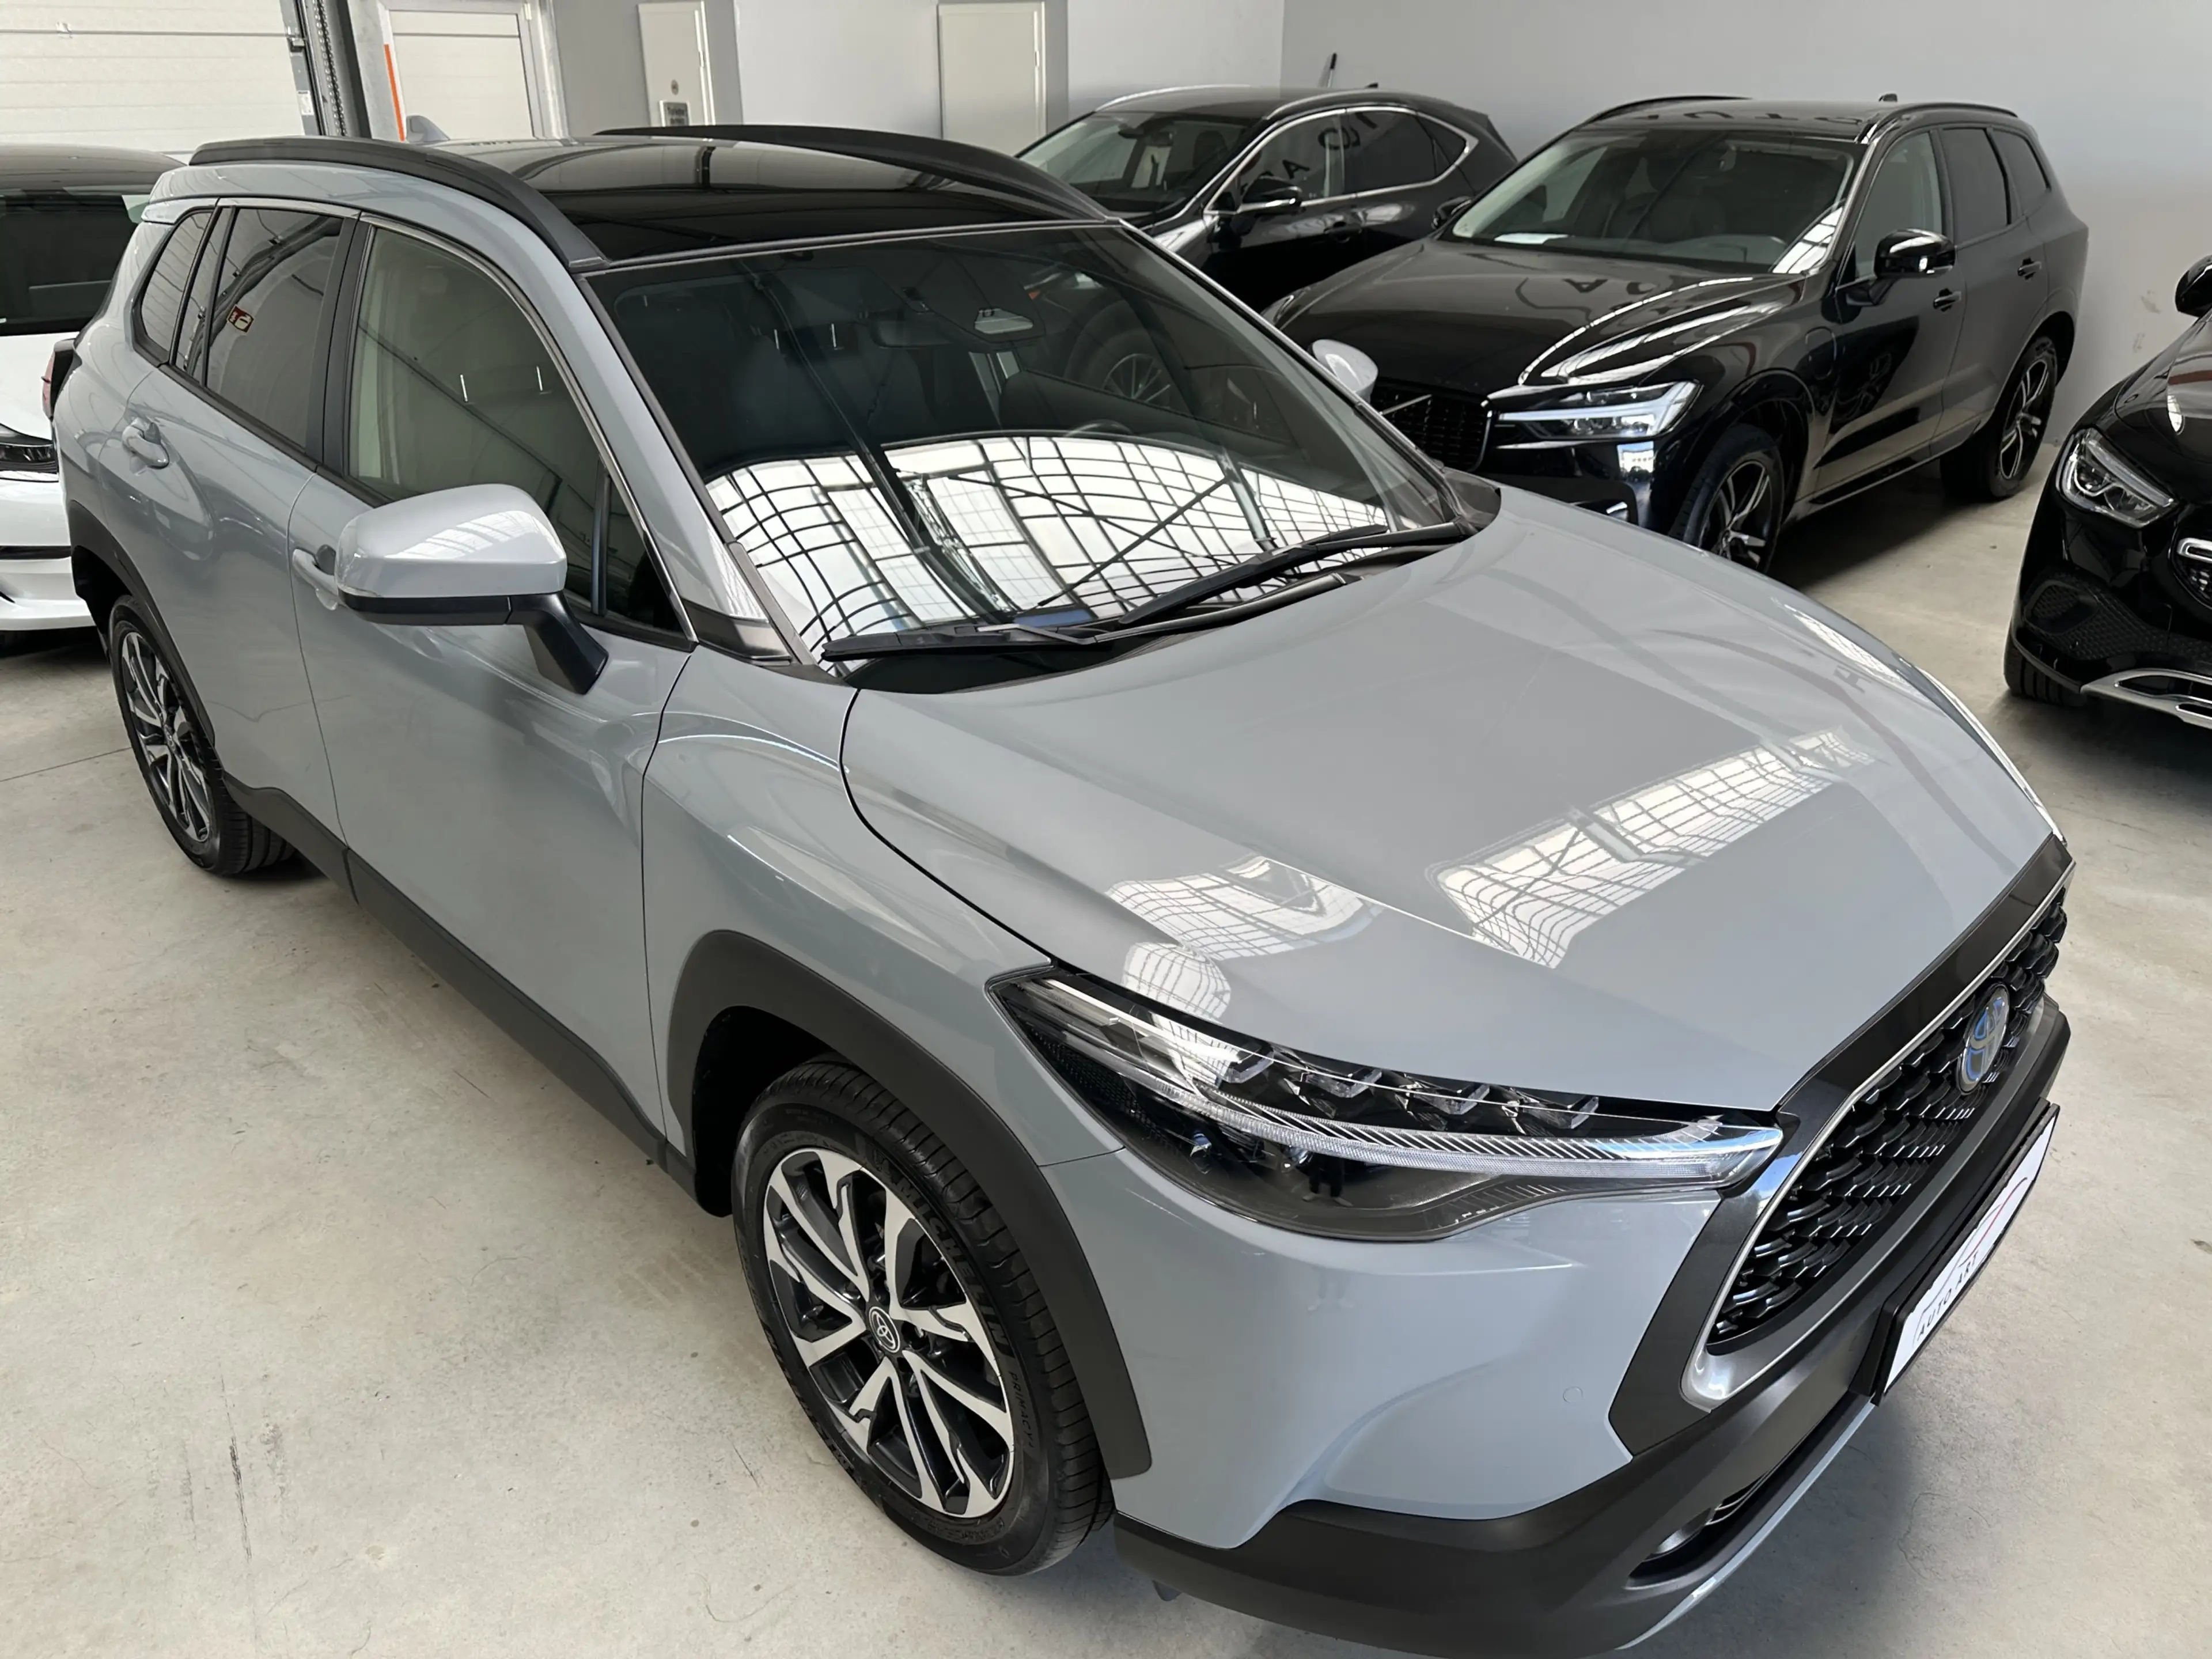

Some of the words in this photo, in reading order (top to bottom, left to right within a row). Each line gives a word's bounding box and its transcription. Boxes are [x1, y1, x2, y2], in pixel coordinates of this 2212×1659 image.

[896, 1177, 1009, 1346] MICHELIN
[1917, 1288, 1952, 1341] AUTO
[1955, 1250, 1979, 1290] ART
[1008, 1370, 1033, 1441] PRIMACY
